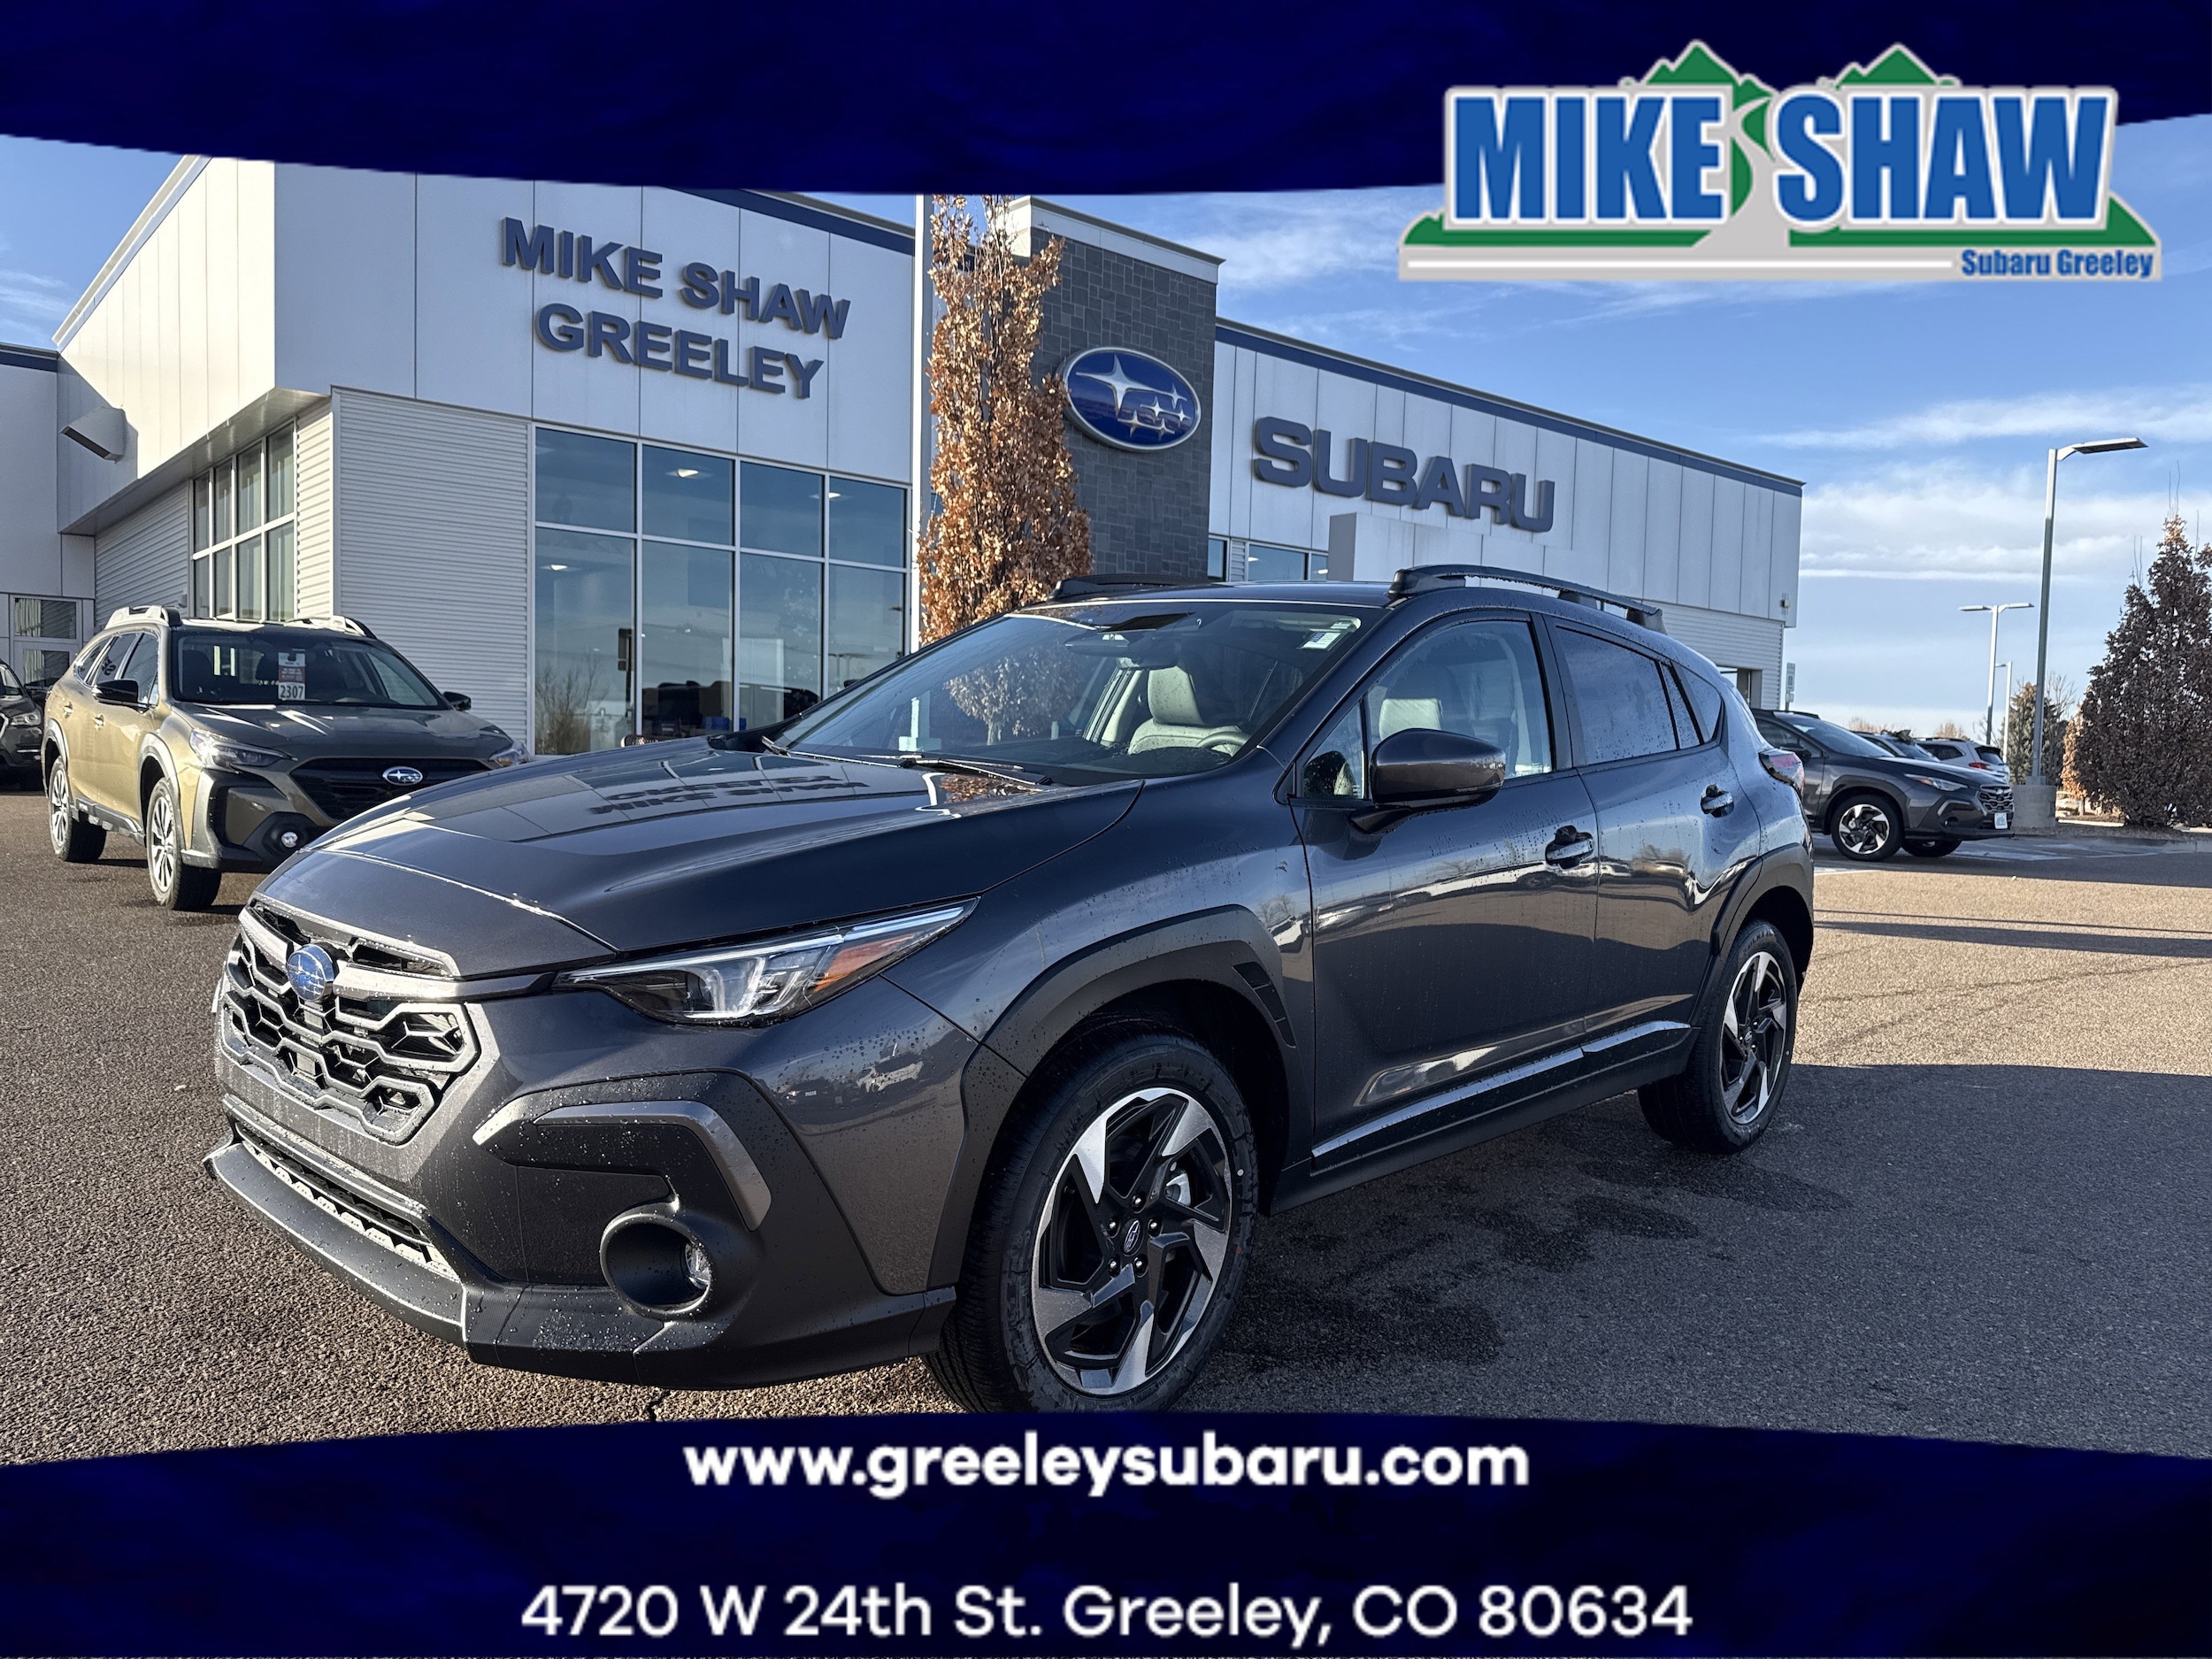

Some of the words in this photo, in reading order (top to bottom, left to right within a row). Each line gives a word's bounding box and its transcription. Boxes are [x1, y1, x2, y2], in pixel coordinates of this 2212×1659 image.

[503, 217, 663, 298] MIKE
[679, 262, 851, 340] SHAW
[536, 303, 824, 399] GREELEY
[1255, 416, 1555, 533] SUBARU
[280, 685, 303, 699] 2307
